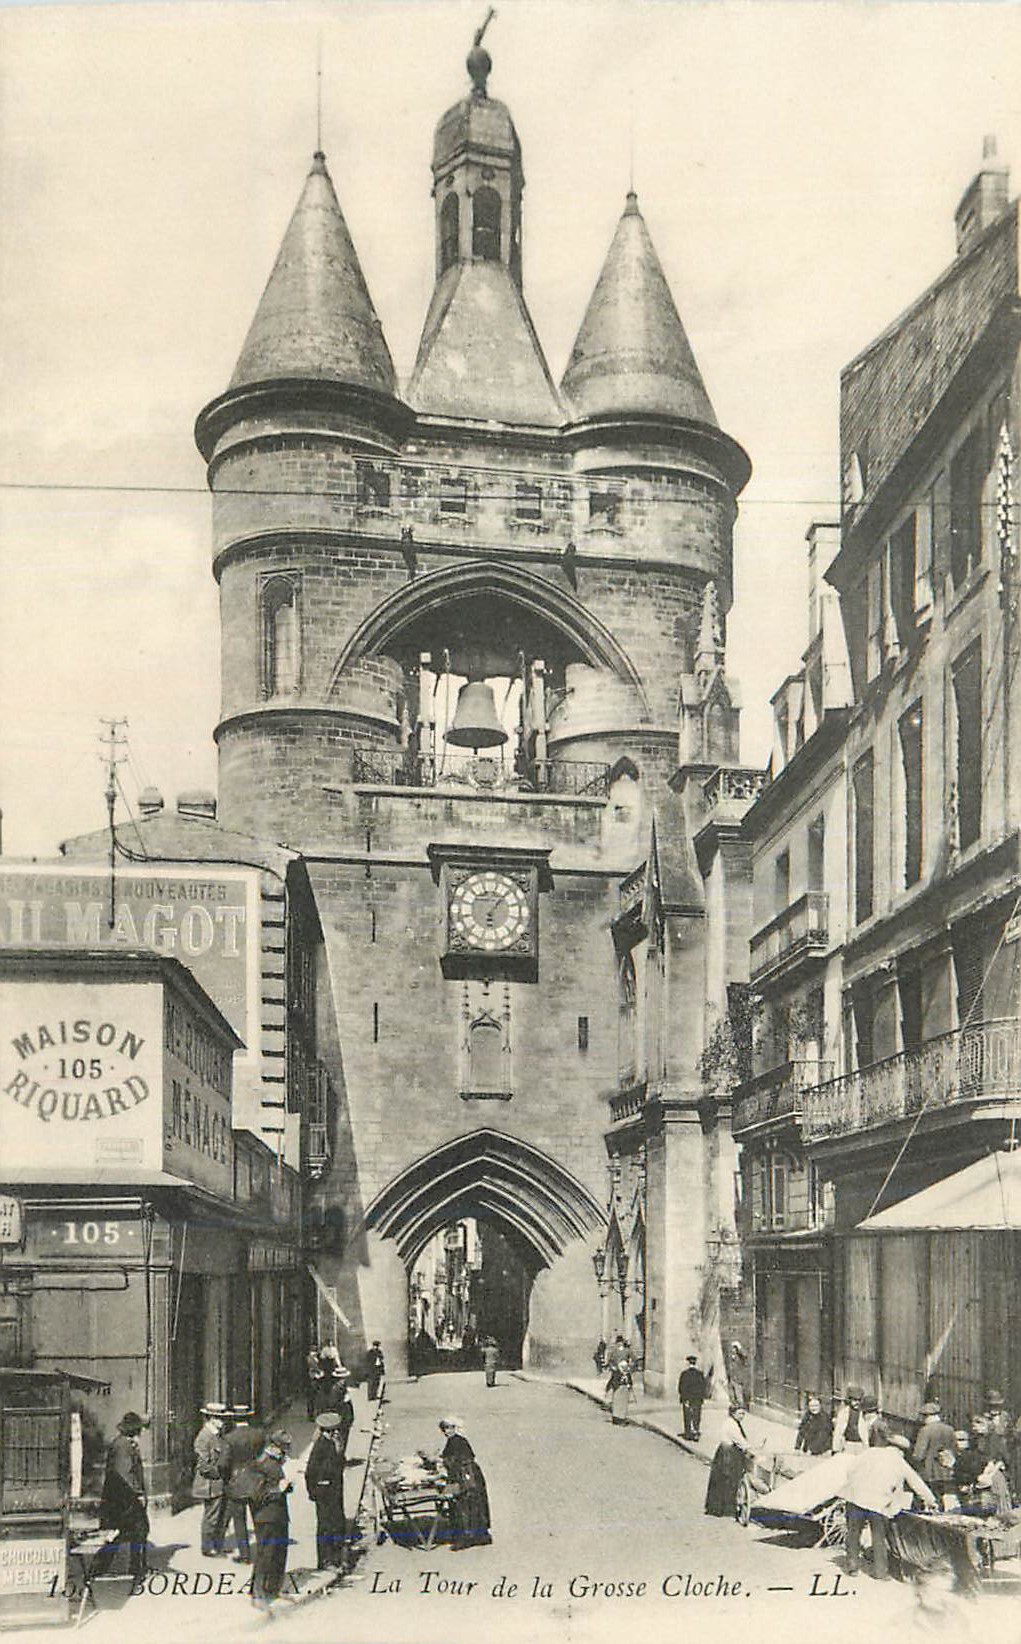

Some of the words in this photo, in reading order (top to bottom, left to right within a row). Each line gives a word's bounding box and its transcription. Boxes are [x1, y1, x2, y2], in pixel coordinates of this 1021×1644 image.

[63, 901, 246, 957] MAGOT
[11, 1019, 146, 1061] MAISON
[58, 1058, 103, 1080] 105
[3, 1069, 151, 1123] RIQUARD
[63, 1221, 120, 1245] 105
